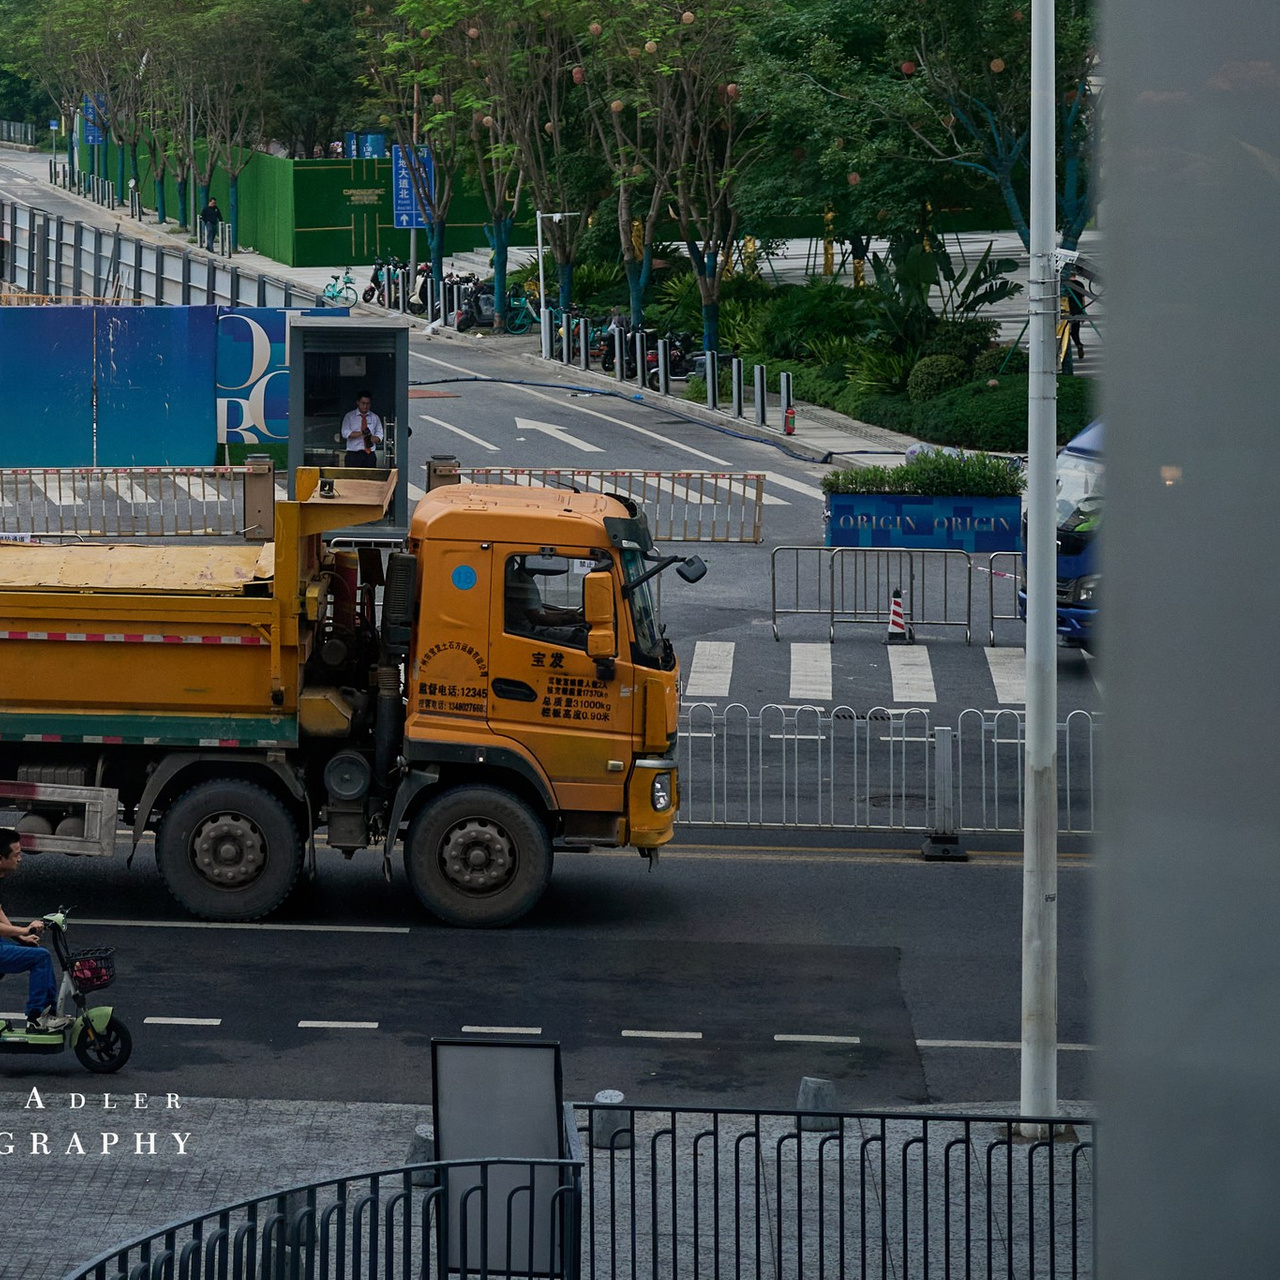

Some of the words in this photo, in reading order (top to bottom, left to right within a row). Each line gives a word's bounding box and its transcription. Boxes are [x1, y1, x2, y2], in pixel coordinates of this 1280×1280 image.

[839, 514, 917, 531] ORIGIN
[933, 516, 1011, 532] ORIGIN
[531, 651, 565, 669] 宝发
